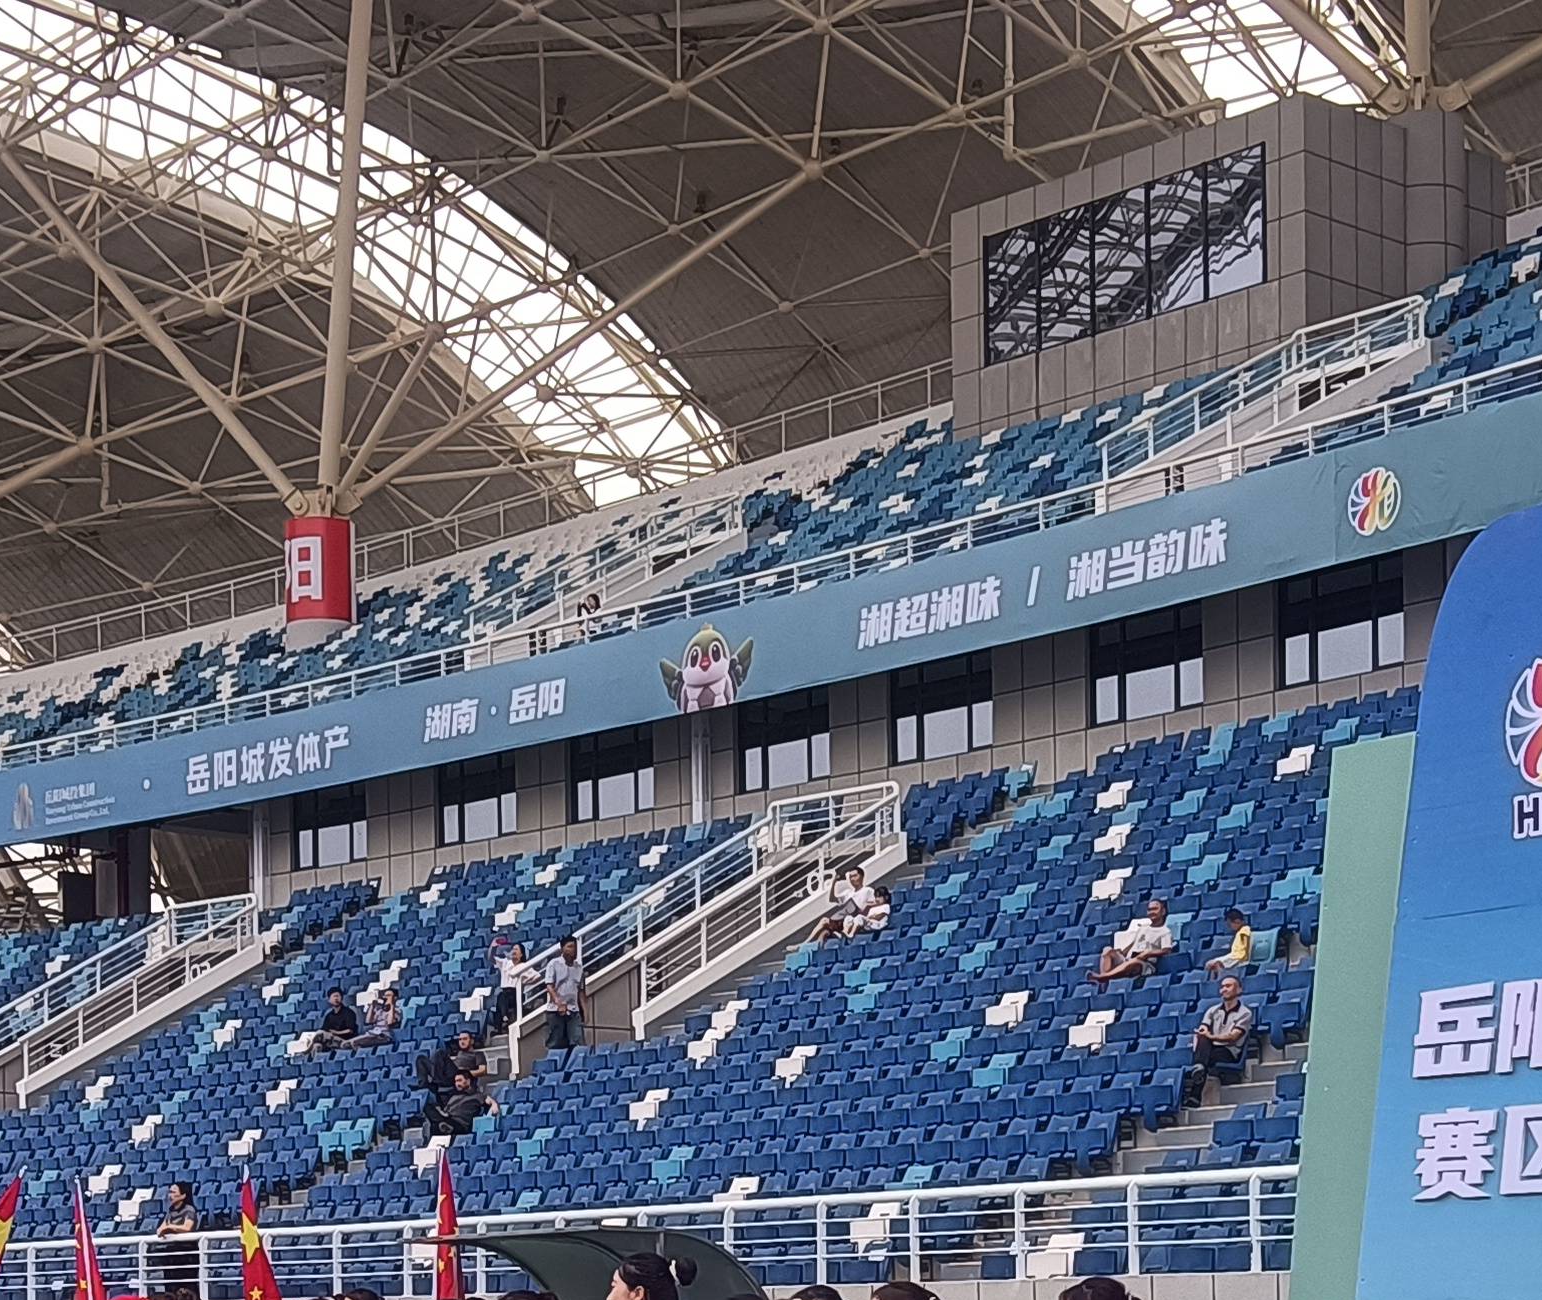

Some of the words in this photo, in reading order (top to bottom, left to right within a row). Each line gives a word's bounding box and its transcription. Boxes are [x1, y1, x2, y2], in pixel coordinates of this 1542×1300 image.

[857, 575, 1002, 651] 湘超湘味
[1066, 516, 1228, 601] 湘当韵味
[186, 725, 351, 796] 岳阳城发体产
